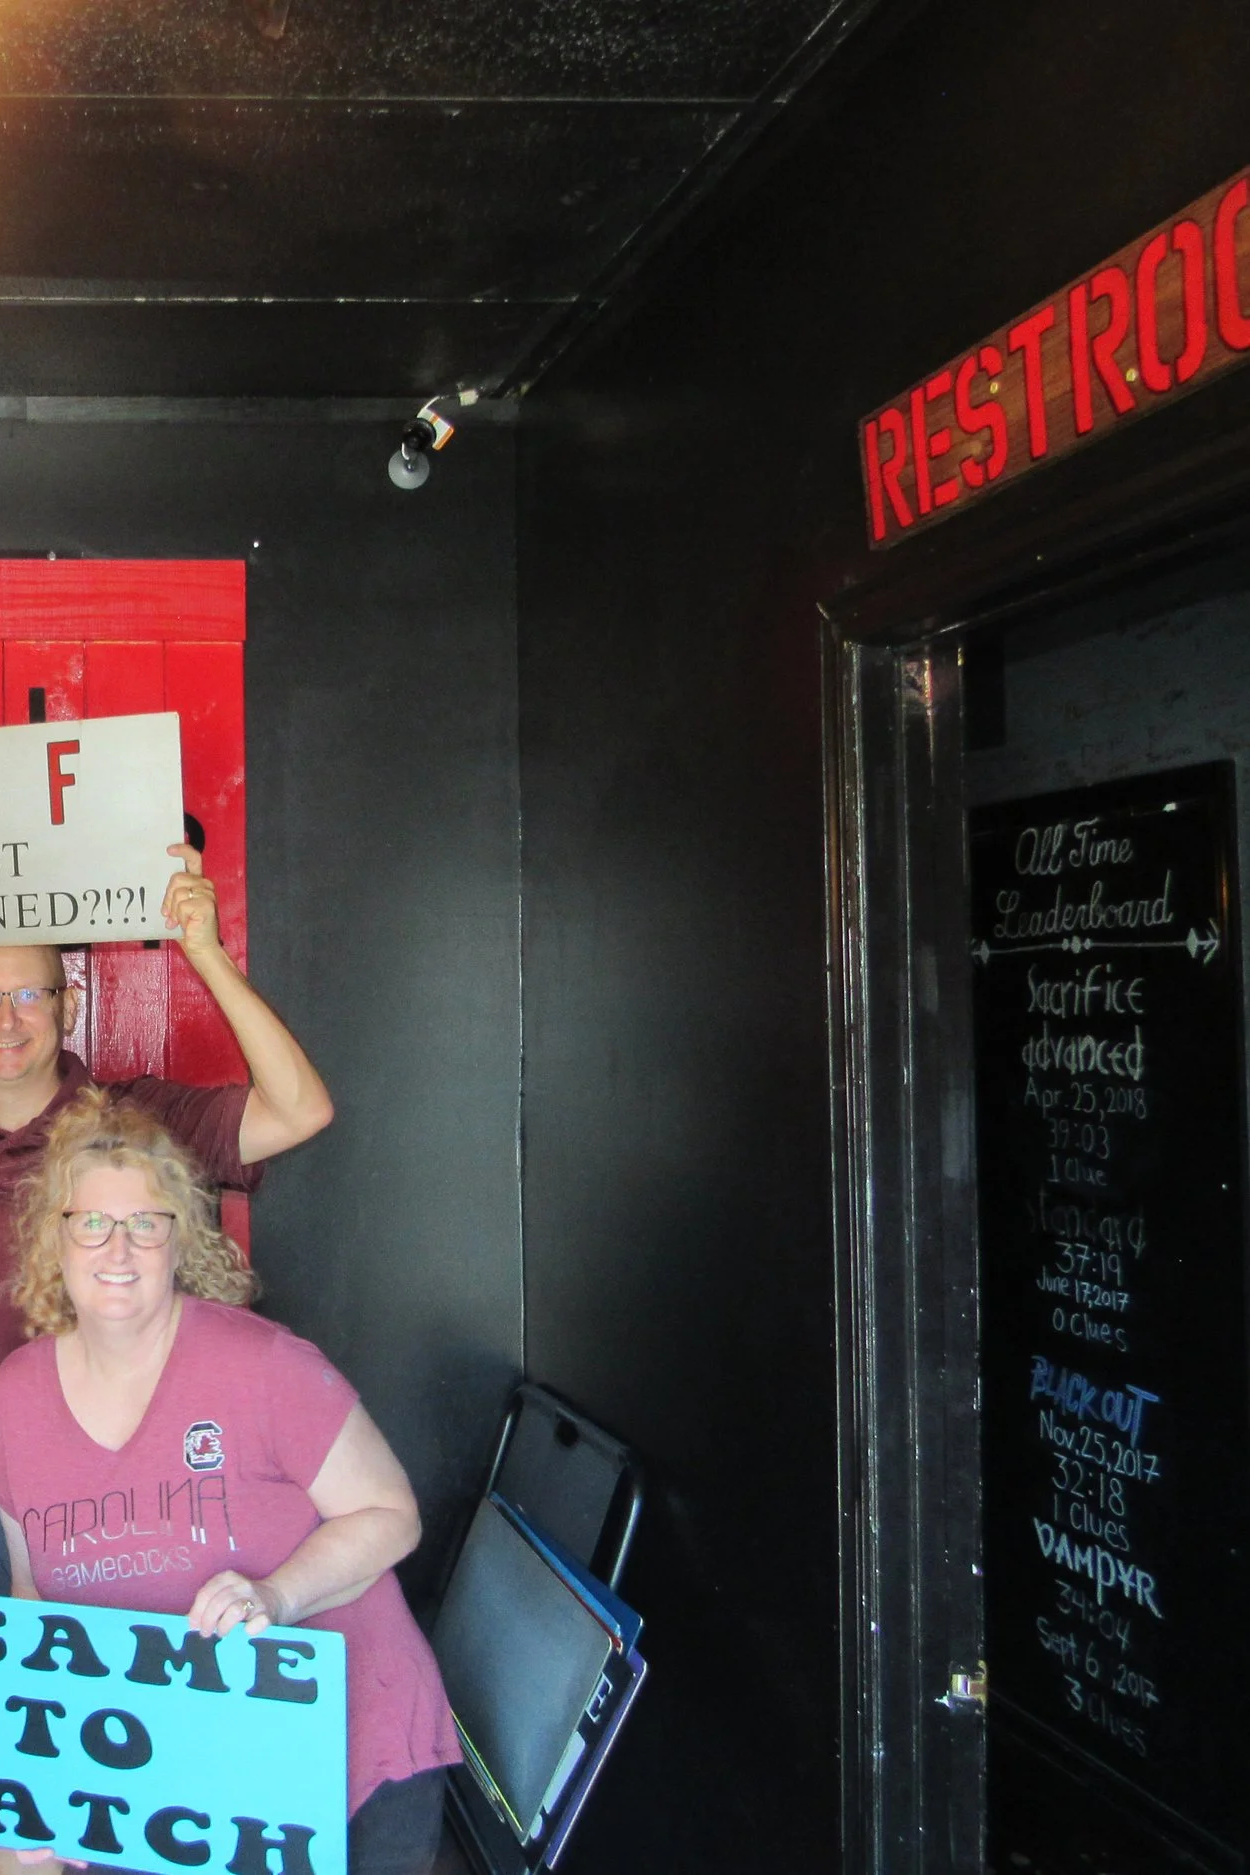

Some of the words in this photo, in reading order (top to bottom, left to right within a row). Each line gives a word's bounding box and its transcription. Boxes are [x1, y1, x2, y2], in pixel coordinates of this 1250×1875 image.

[1015, 823, 1064, 876] All
[1069, 817, 1133, 868] Time
[993, 868, 1174, 939] Leaderboard
[1021, 1020, 1145, 1081] advanced
[1047, 1117, 1111, 1160] 39:03
[1036, 1264, 1071, 1297] June
[1054, 1240, 1124, 1287] 37:19
[1052, 1452, 1126, 1517] 32:18
[1033, 1515, 1166, 1619] DAMPYR
[1062, 1673, 1084, 1712] 3
[5, 1694, 153, 1770] TO
